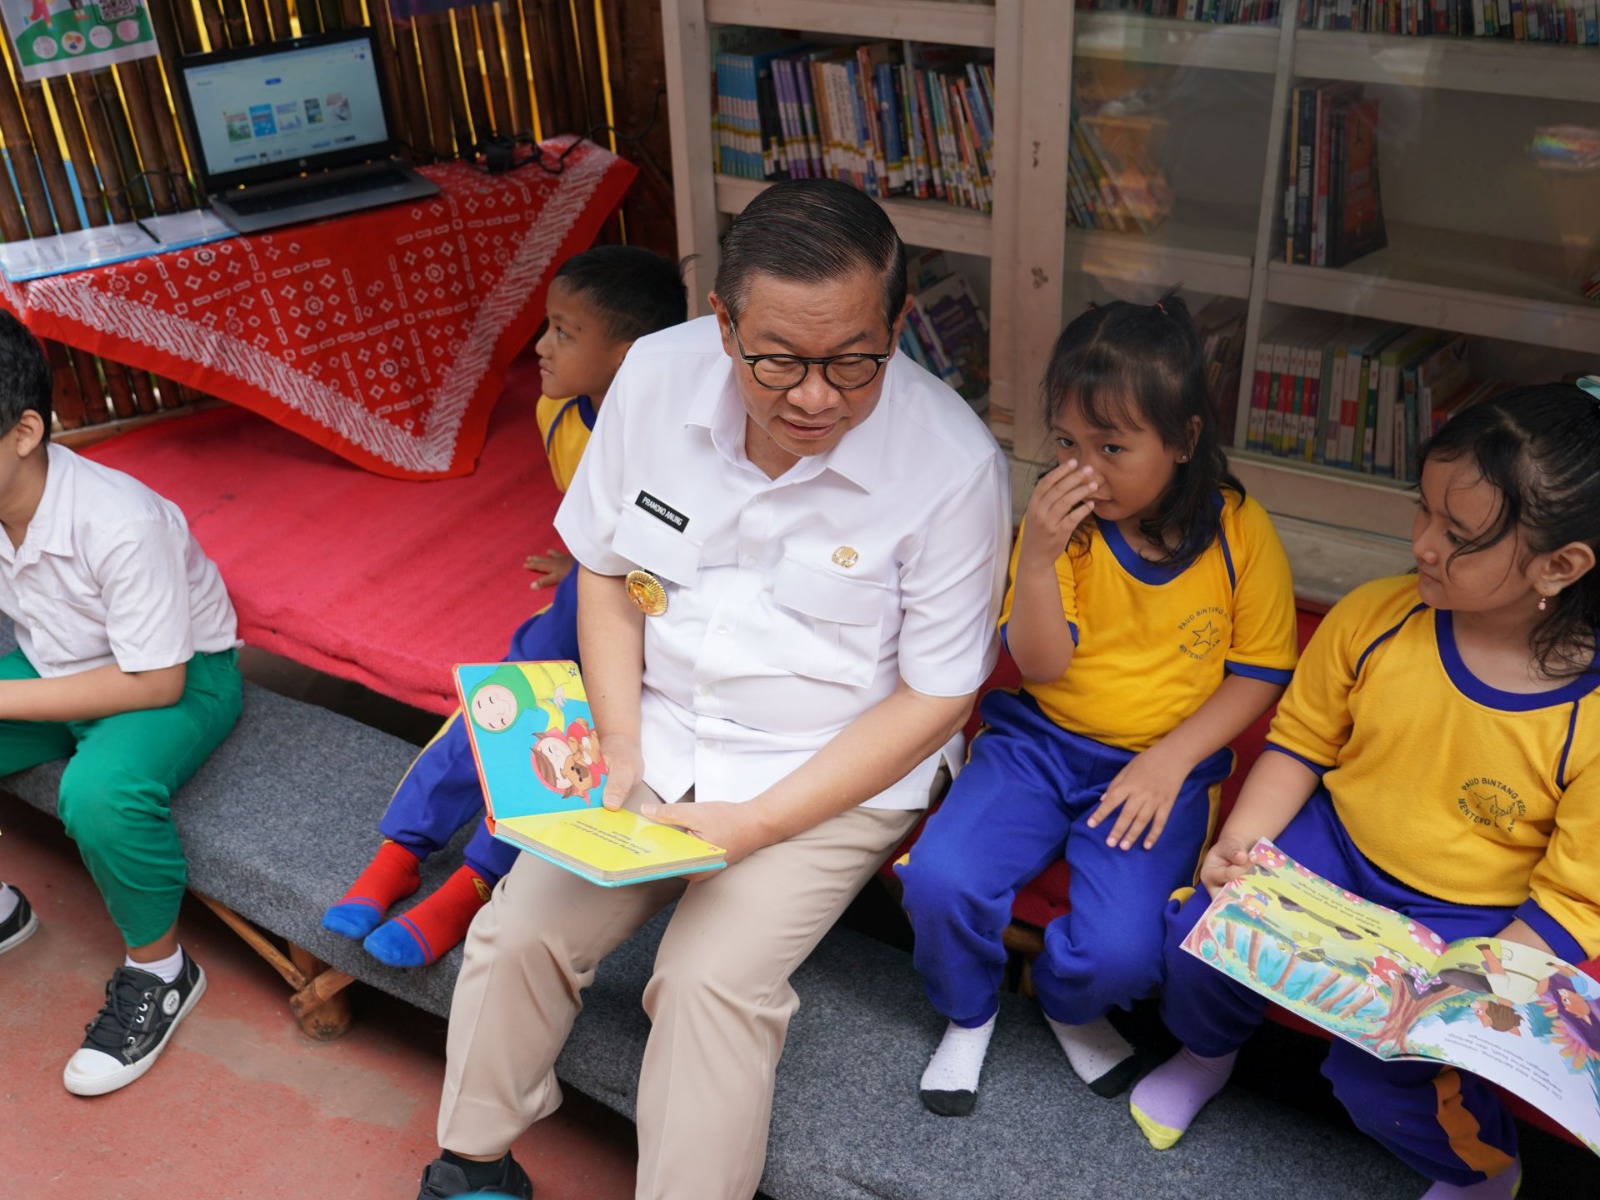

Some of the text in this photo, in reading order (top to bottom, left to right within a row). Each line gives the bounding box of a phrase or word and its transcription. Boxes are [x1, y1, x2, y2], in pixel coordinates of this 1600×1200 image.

[1299, 145, 1311, 166] DATA
[641, 496, 683, 526] PRAMONO ANUNG
[1178, 614, 1195, 630] PAUD
[1461, 778, 1480, 791] PAUD
[1481, 777, 1519, 800] BINTANG
